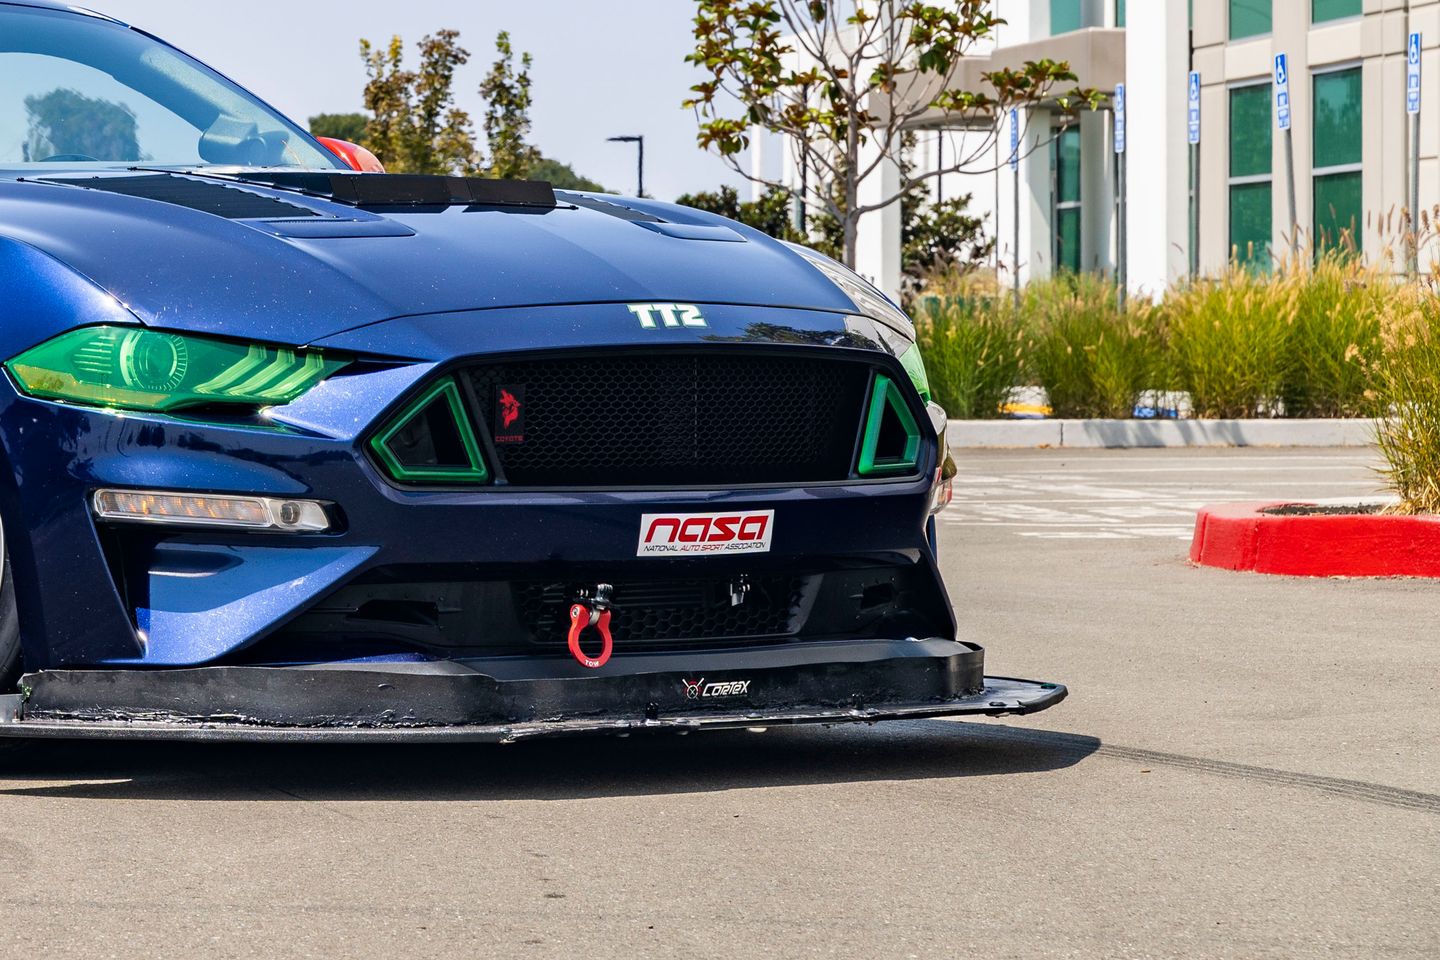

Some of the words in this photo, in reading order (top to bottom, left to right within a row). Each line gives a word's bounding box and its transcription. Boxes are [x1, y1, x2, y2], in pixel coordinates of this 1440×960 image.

[626, 303, 708, 328] TT2
[643, 544, 678, 552] NATIONAL
[701, 543, 725, 551] SPORT
[724, 541, 766, 550] ASSOCIATION
